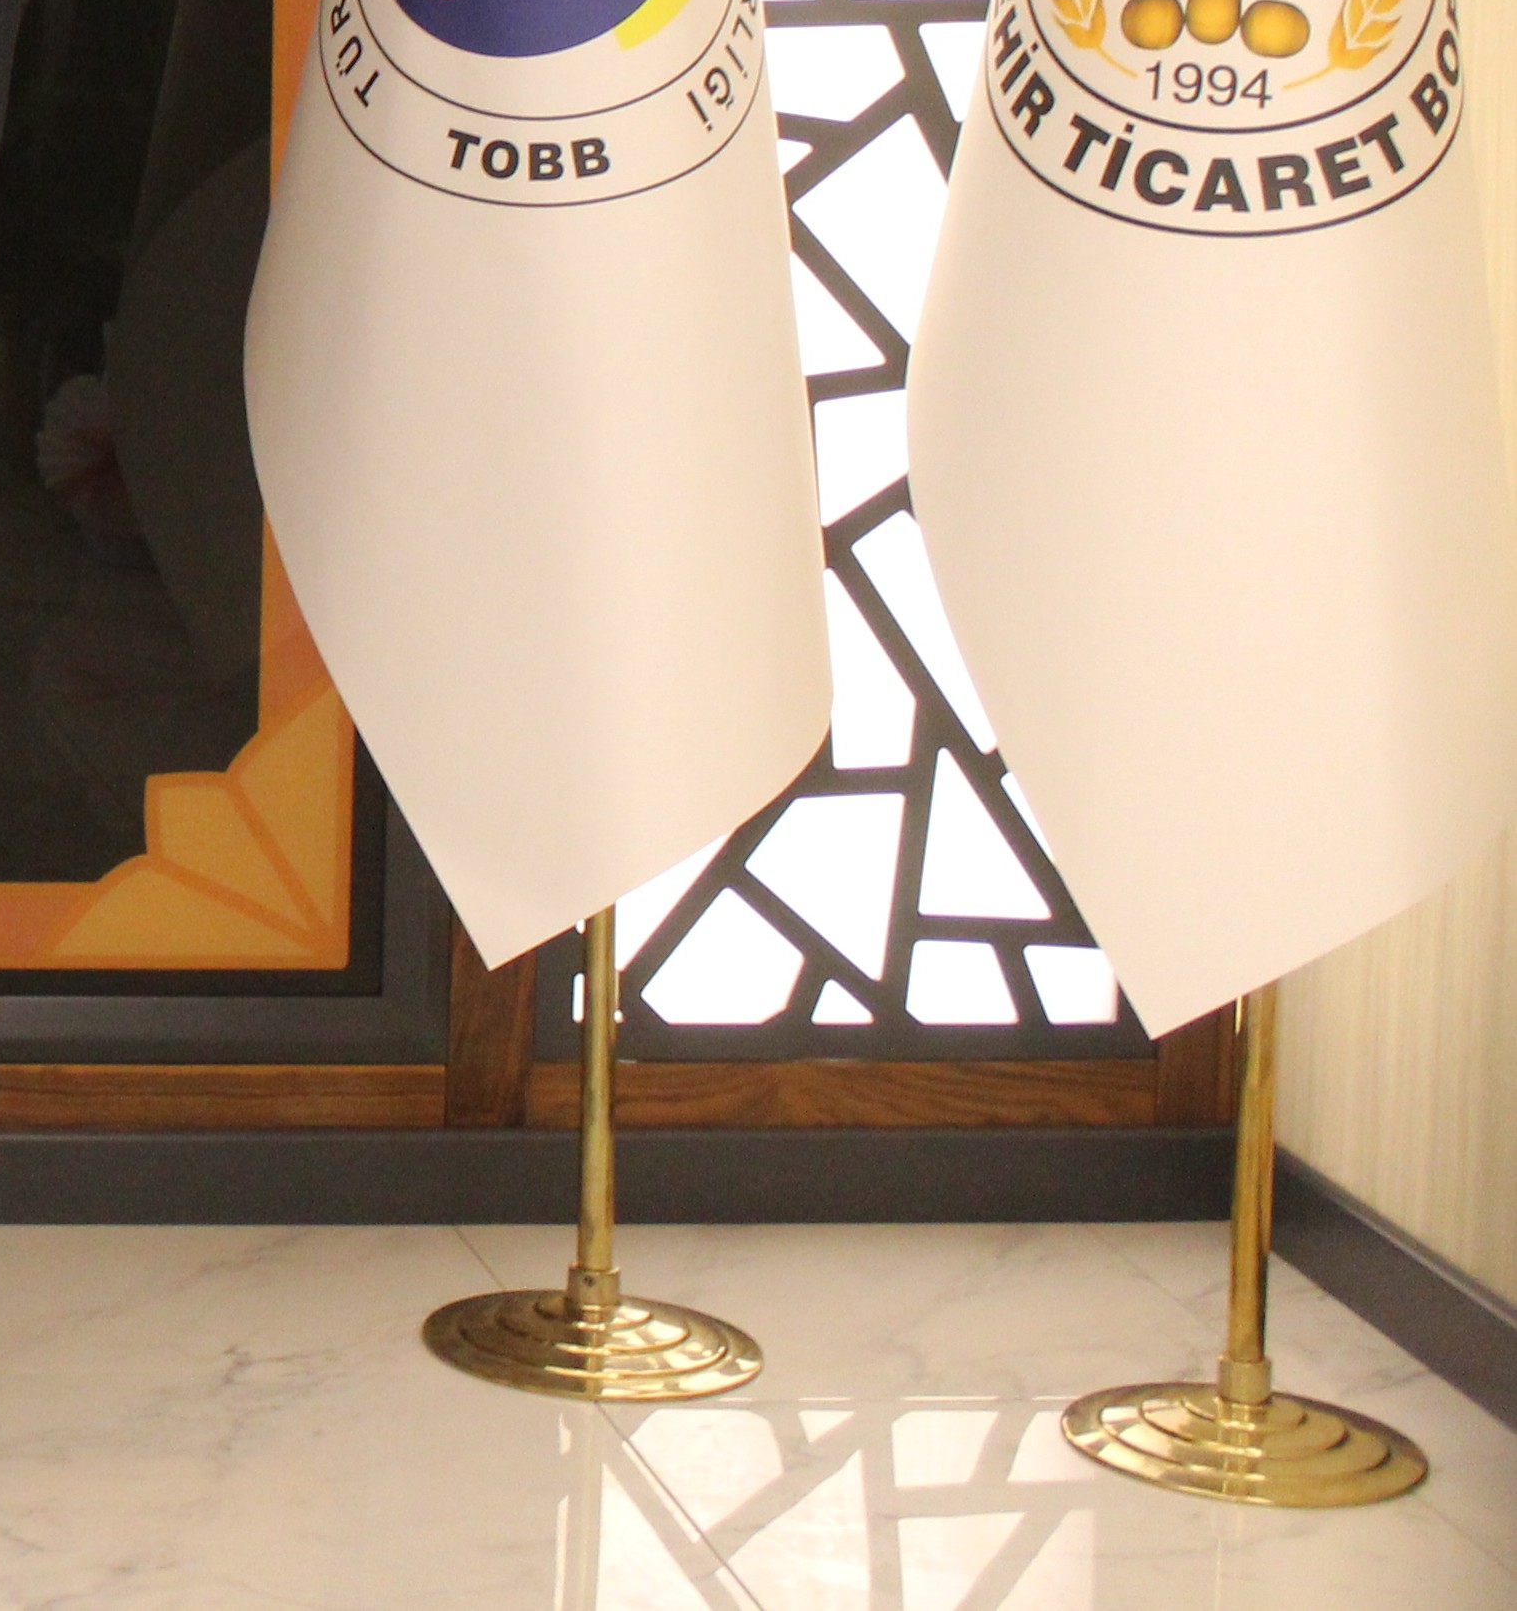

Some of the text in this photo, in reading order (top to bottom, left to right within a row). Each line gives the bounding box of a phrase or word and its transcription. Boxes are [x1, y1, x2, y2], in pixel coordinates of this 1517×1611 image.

[1145, 60, 1272, 109] 1994
[447, 128, 610, 181] TOBB
[1062, 112, 1406, 213] TİCARET
